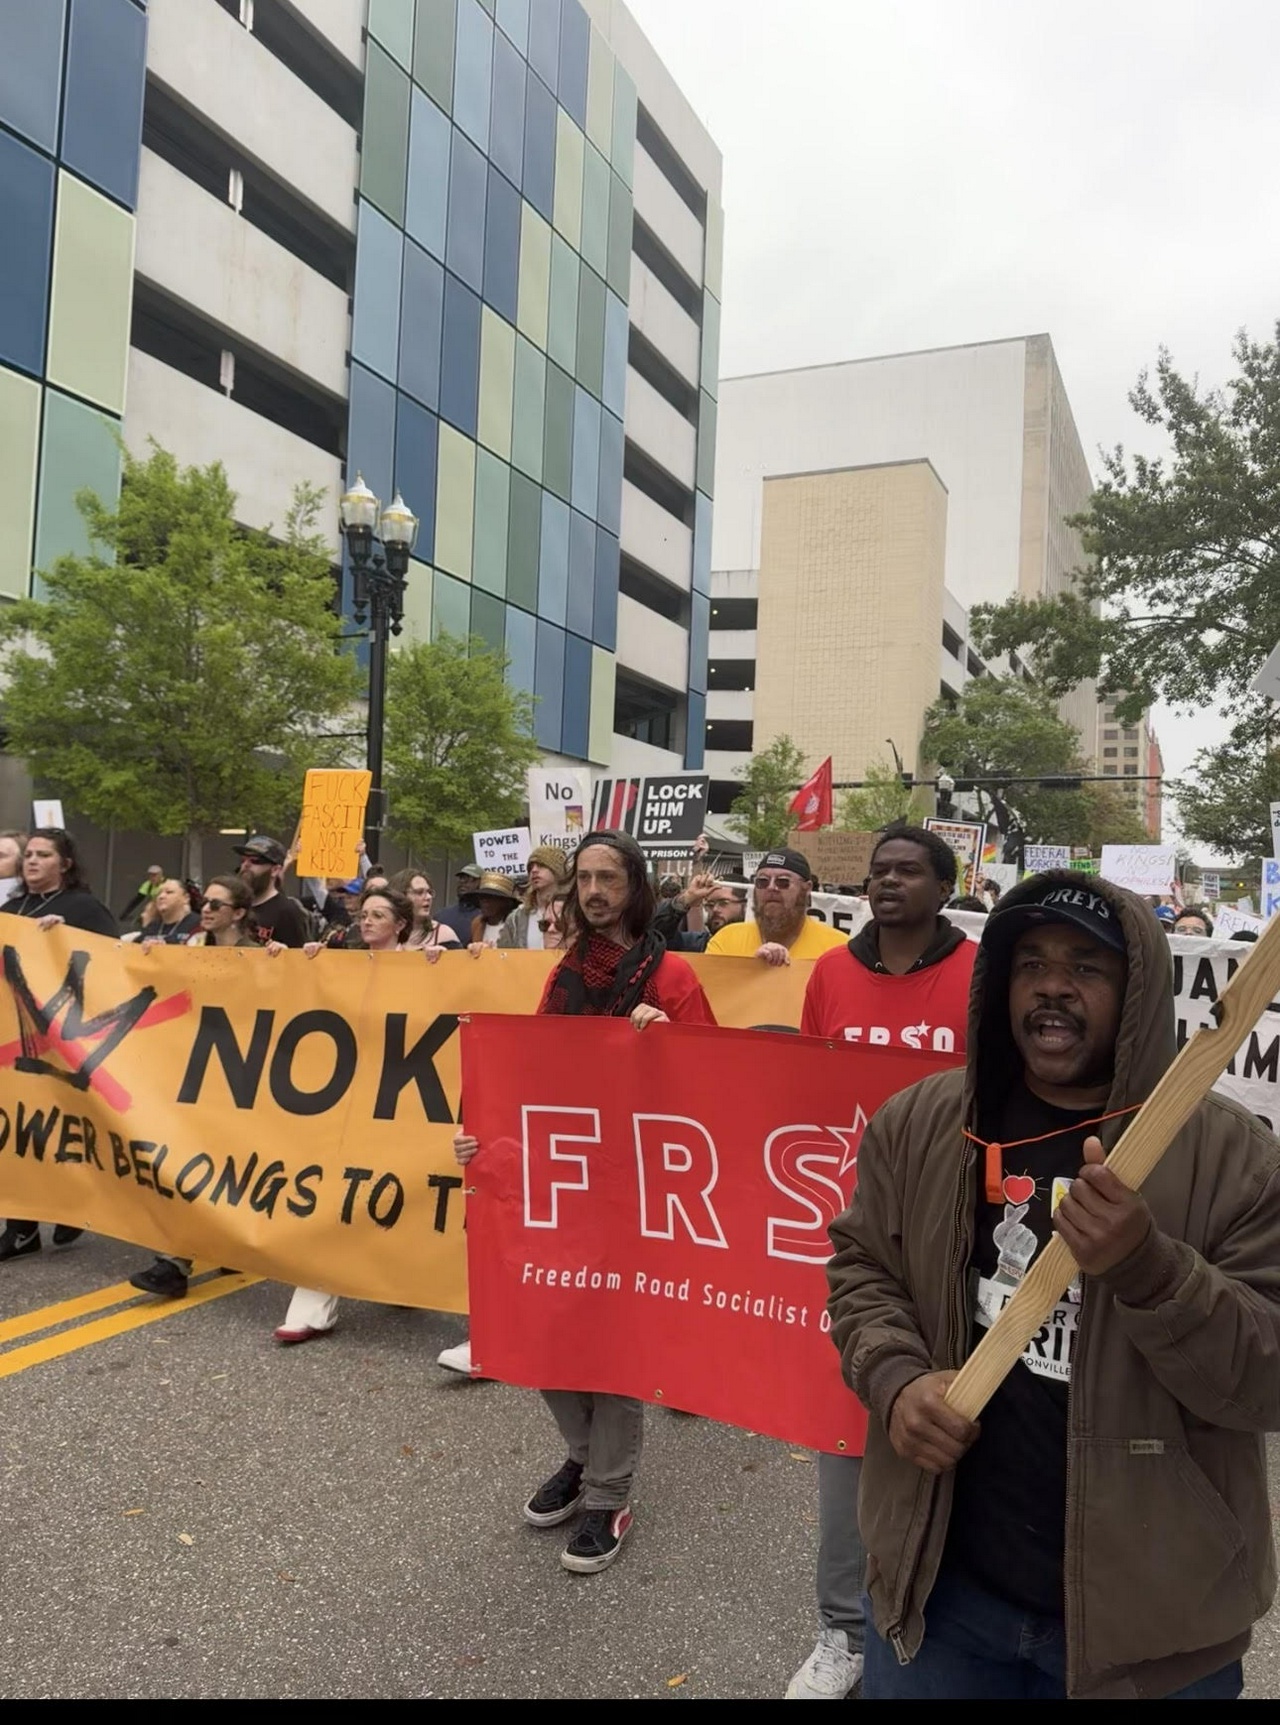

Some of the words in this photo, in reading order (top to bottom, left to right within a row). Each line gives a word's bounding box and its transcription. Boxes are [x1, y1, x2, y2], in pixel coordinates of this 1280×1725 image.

[311, 774, 367, 802] FUCK
[545, 782, 574, 801] No
[647, 784, 704, 800] LOCK
[645, 802, 684, 817] HIM
[643, 819, 673, 834] UP.
[319, 831, 347, 849] NOT
[479, 834, 520, 847] POWER
[311, 848, 345, 873] KIDS
[484, 850, 496, 858] TO
[502, 852, 519, 861] THE
[650, 850, 688, 858] PRISON
[1024, 847, 1067, 859] FEDERAL
[176, 1005, 358, 1116] NO
[372, 1012, 463, 1125] K
[107, 1130, 324, 1220] BELONGS
[337, 1165, 406, 1231] TO
[427, 1173, 466, 1233] T
[521, 1263, 622, 1291] Freedom
[634, 1271, 690, 1302] Road
[703, 1283, 808, 1327] Socialist
